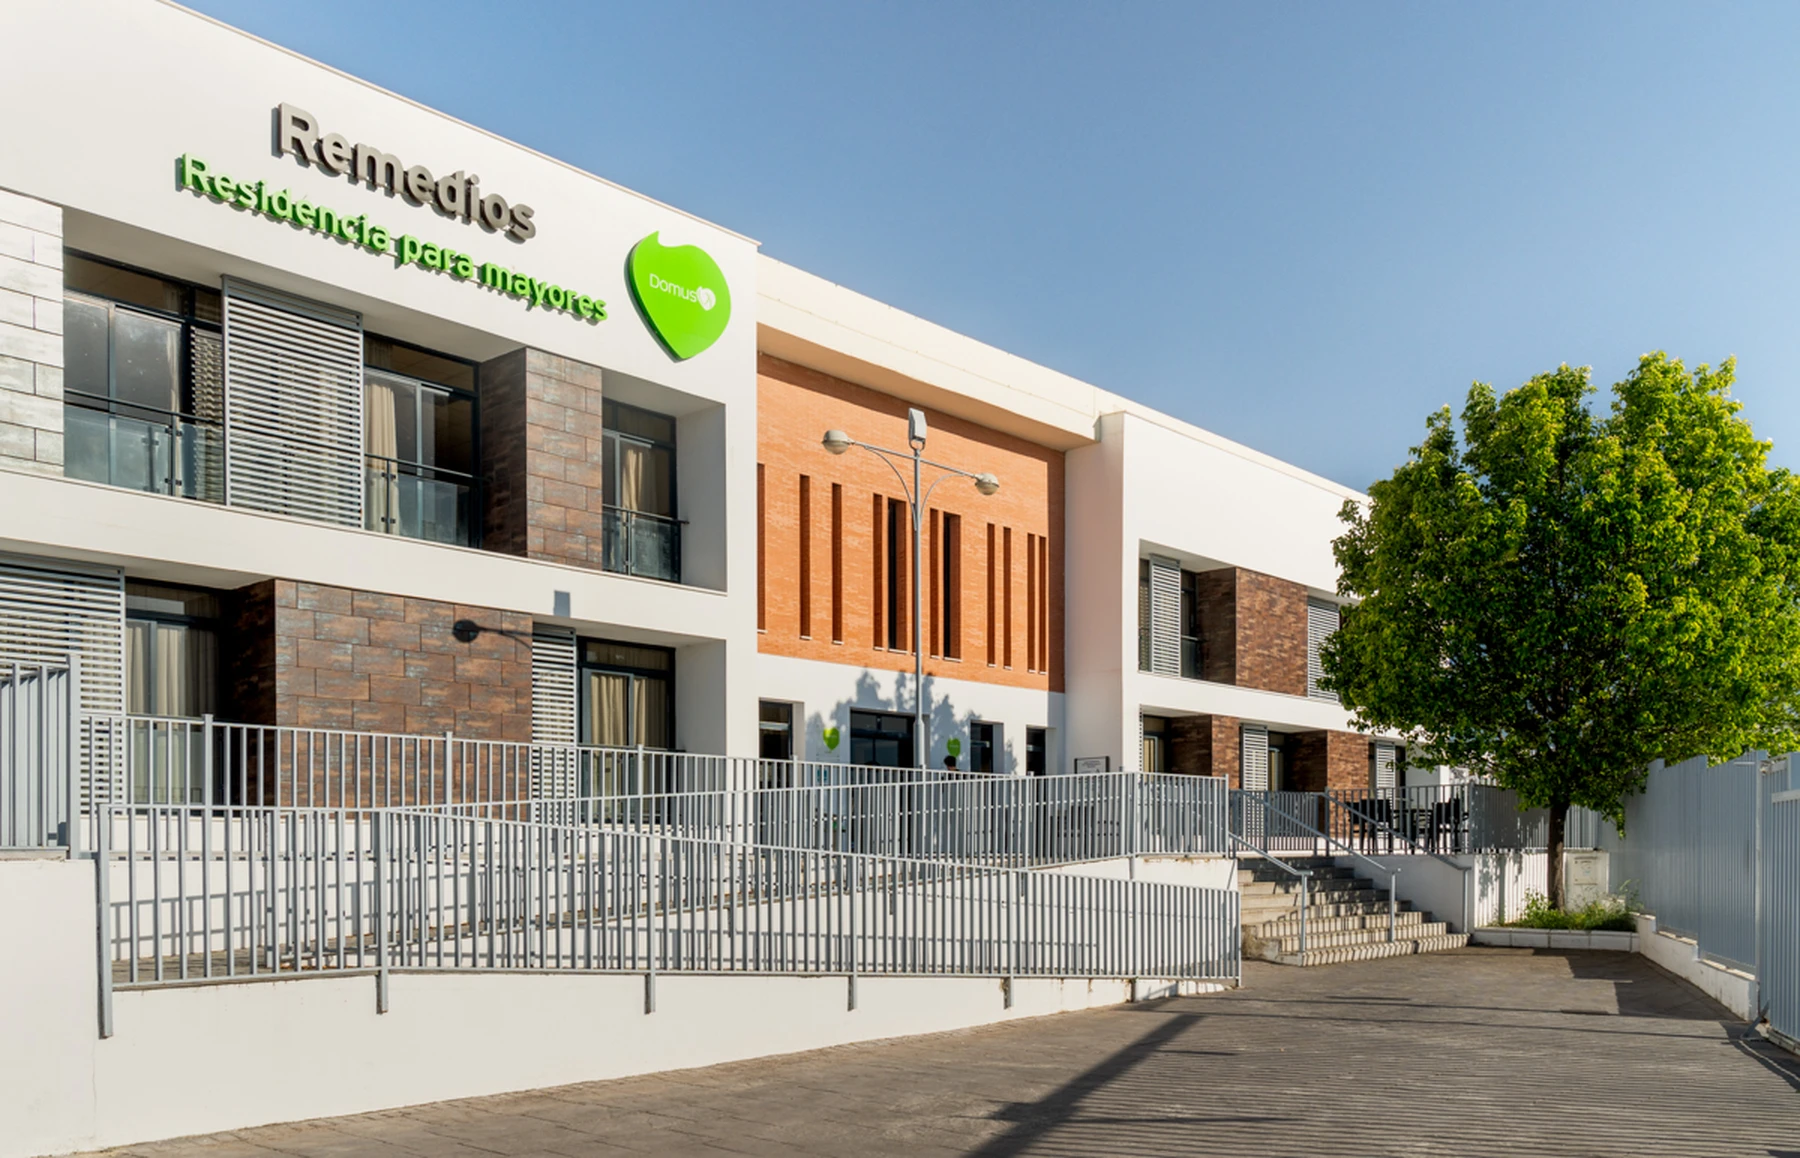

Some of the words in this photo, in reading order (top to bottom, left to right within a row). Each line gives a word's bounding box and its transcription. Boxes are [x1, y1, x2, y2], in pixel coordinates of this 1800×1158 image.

[181, 152, 391, 252] Residencia
[400, 234, 474, 279] para
[481, 262, 608, 321] mayores
[277, 102, 537, 241] Remedios
